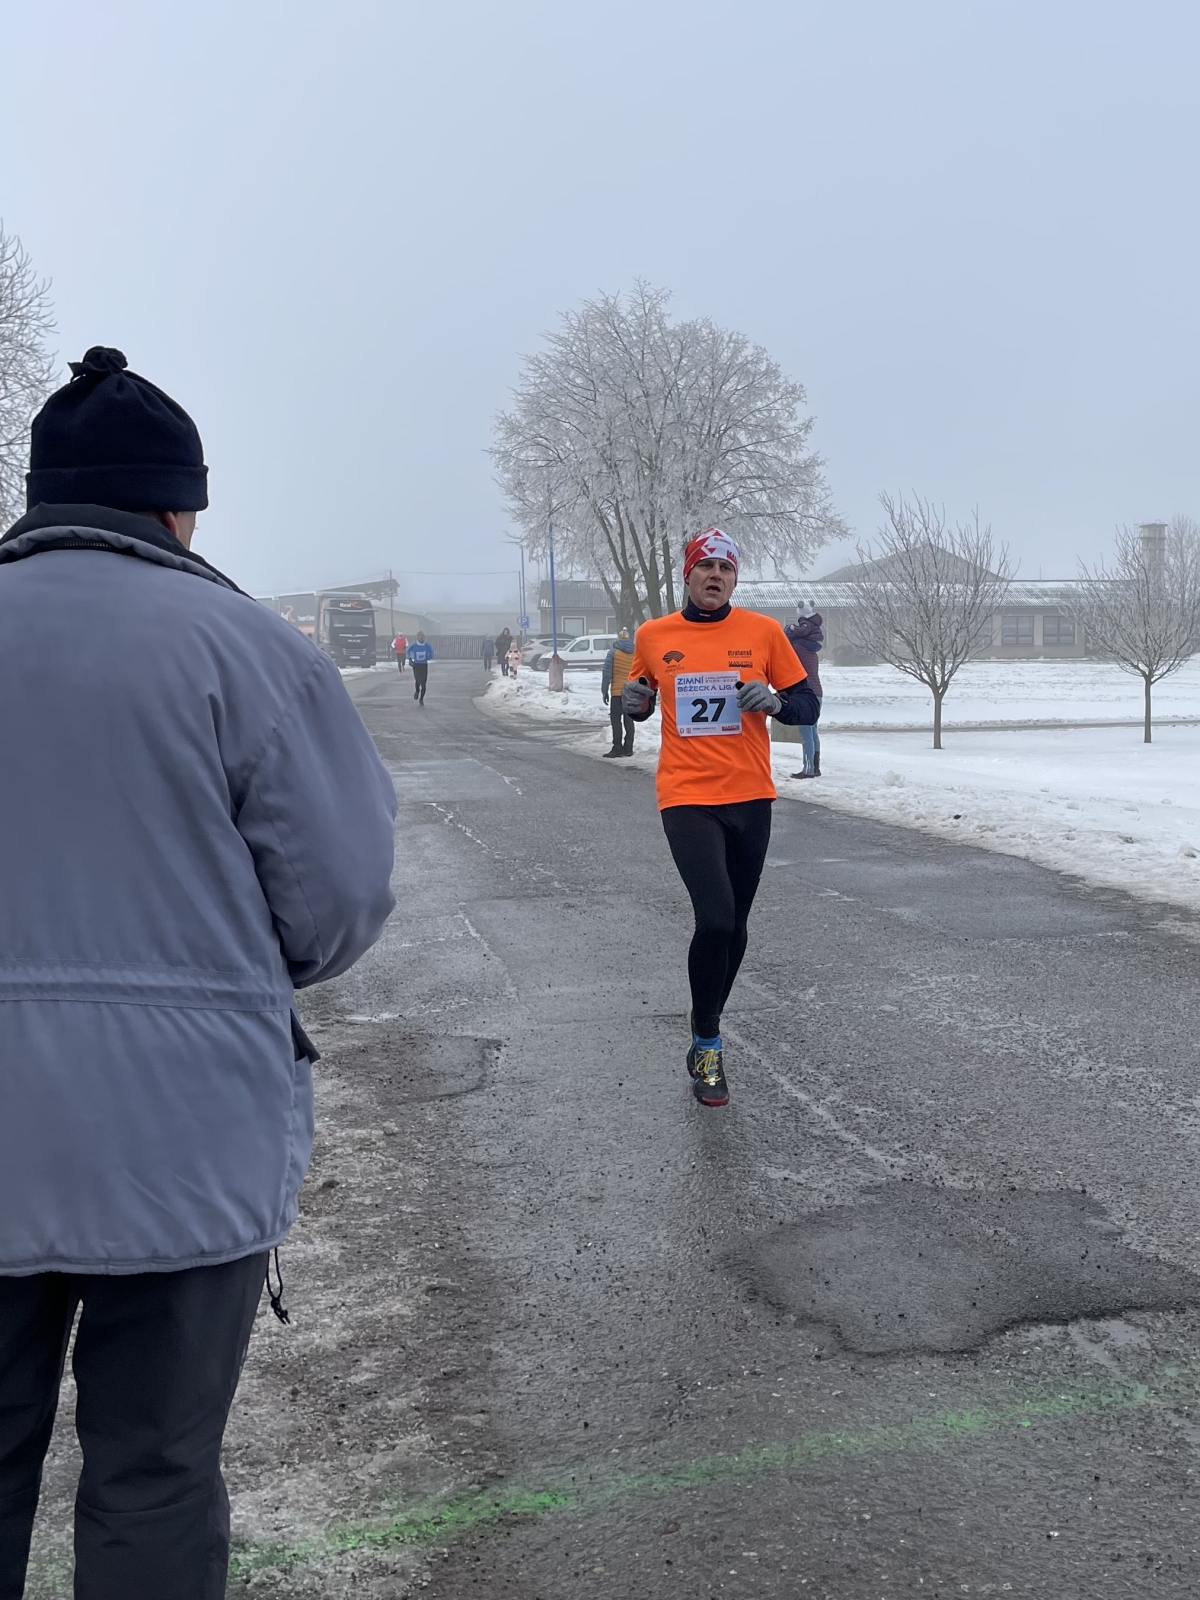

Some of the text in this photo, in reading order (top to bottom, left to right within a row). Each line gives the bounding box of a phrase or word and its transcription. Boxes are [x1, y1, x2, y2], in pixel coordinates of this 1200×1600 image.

[677, 676, 704, 685] ZIMNÍ
[677, 684, 717, 692] BĚŽECKÁ
[691, 697, 726, 723] 27
